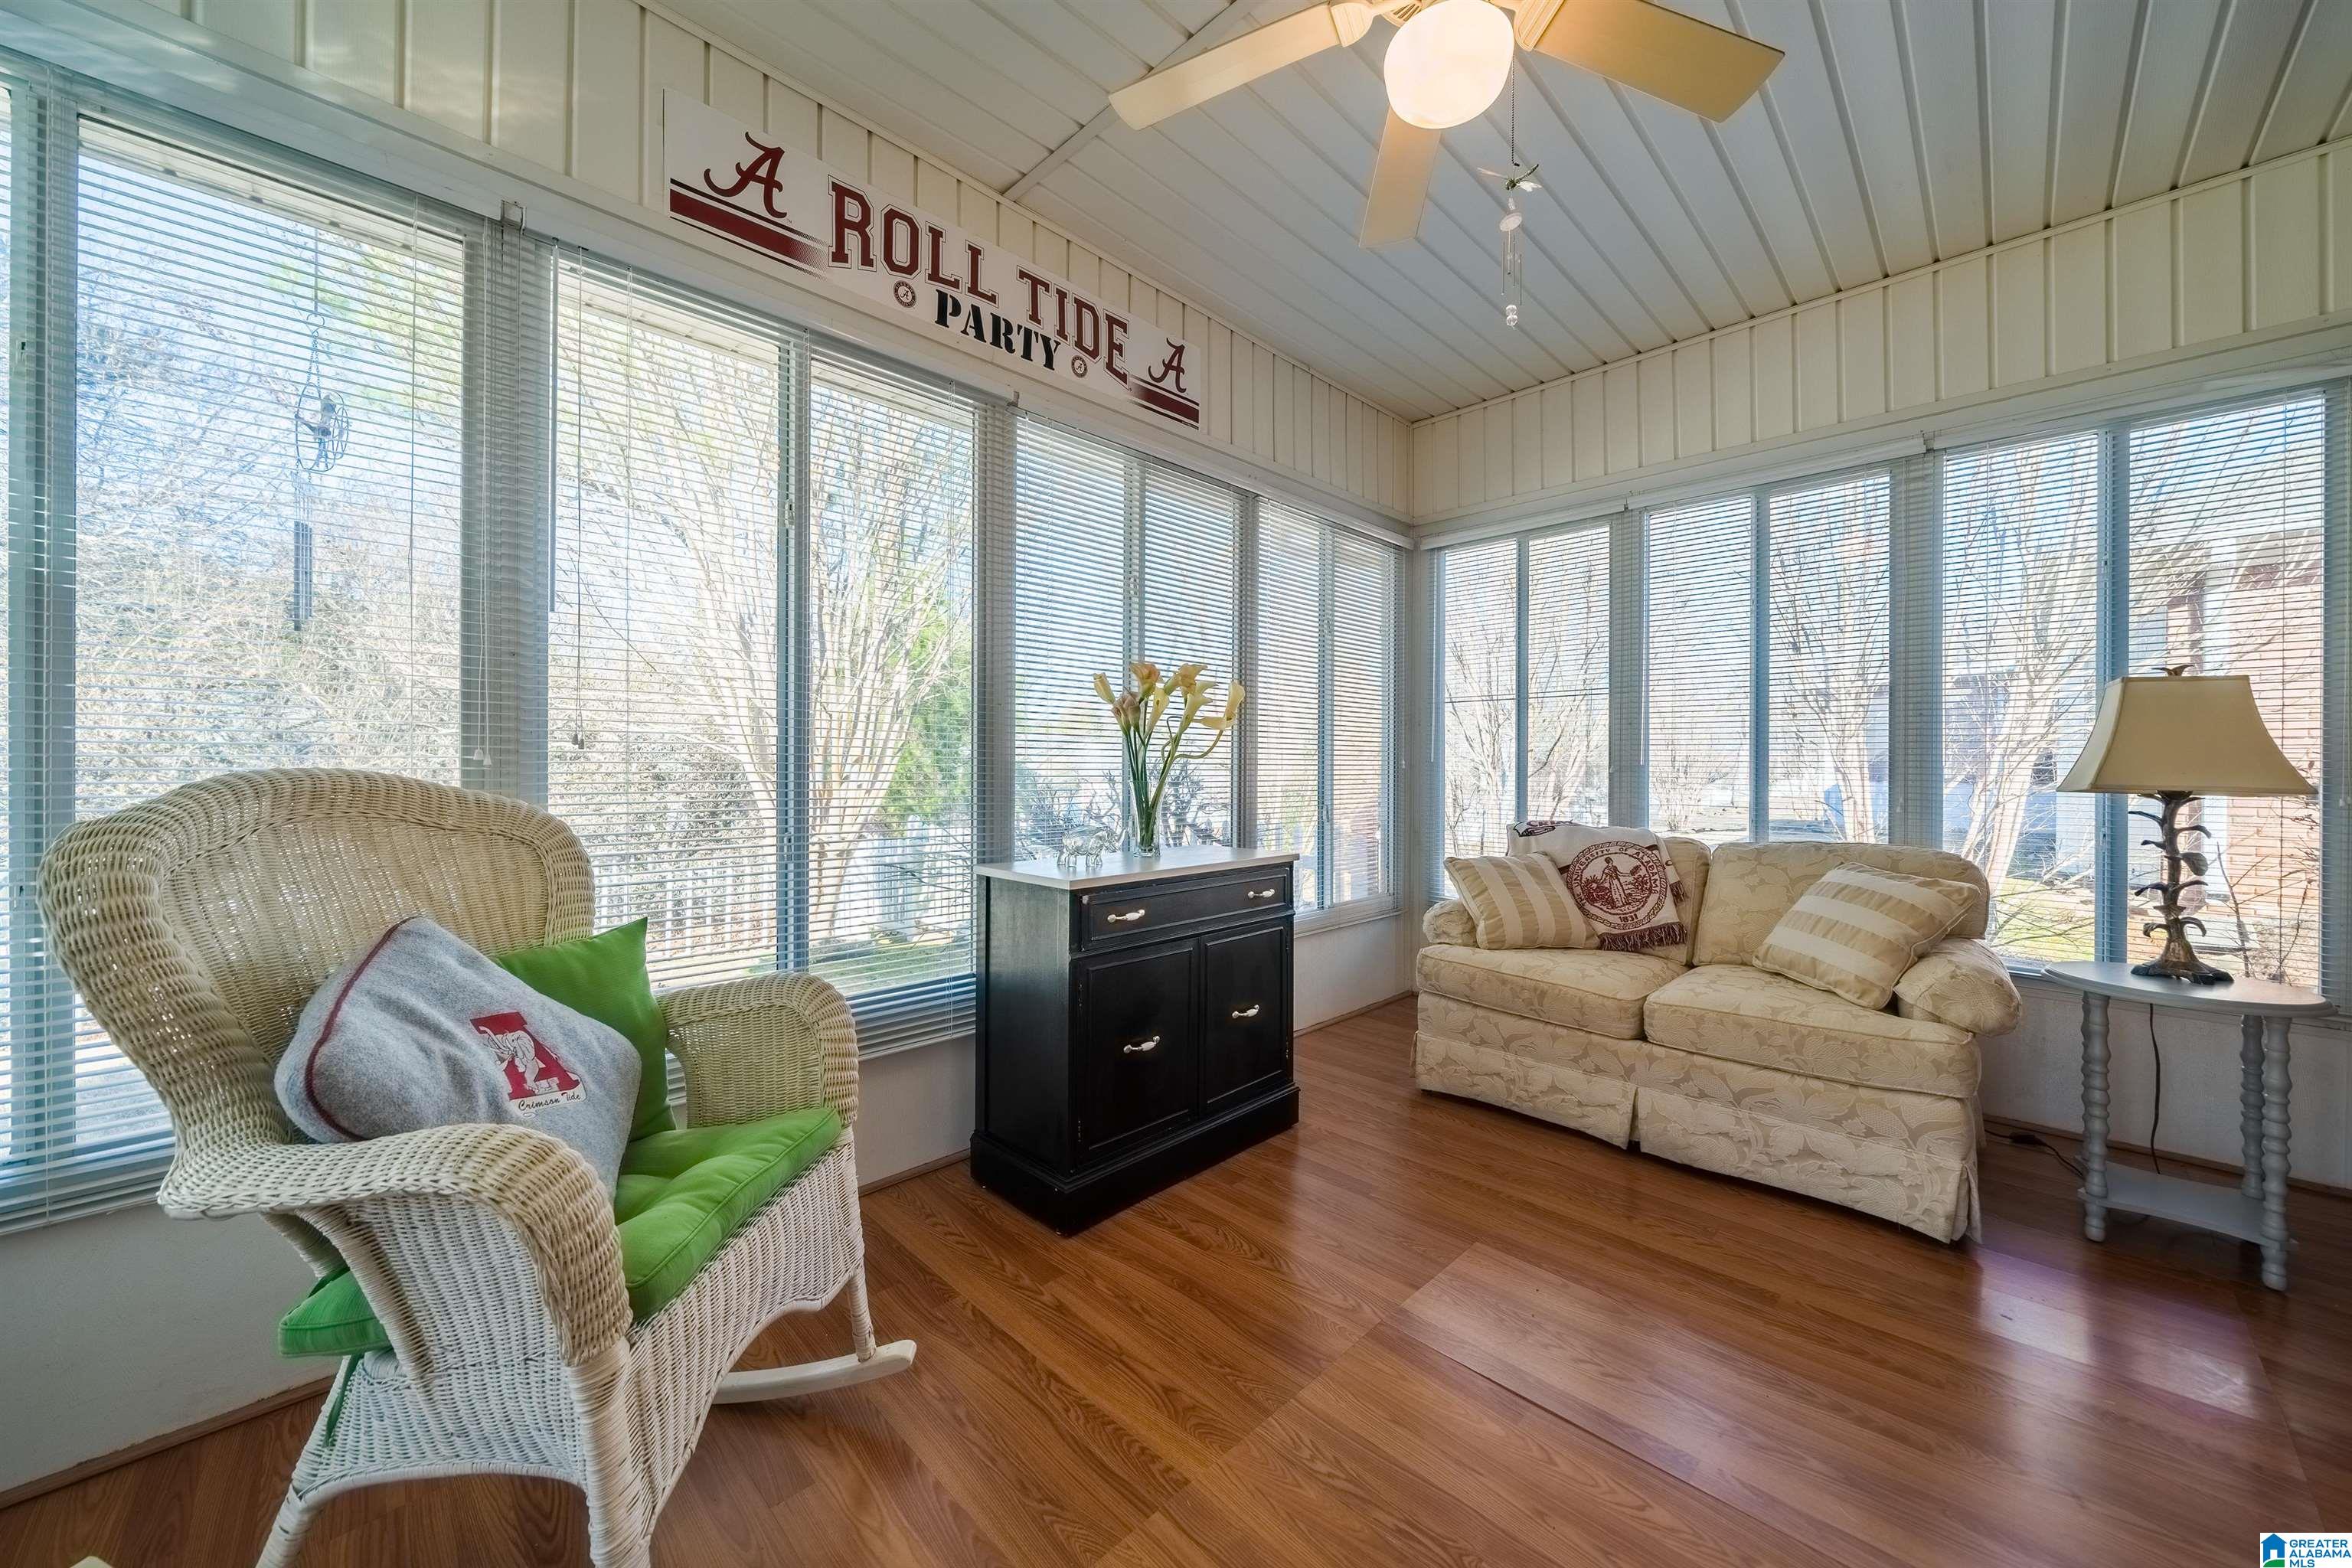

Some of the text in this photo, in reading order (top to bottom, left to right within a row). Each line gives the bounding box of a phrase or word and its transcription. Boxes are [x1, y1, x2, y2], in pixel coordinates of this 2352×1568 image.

[704, 131, 786, 219] A
[828, 174, 1129, 390] ROLL TIDE
[934, 289, 1061, 371] PARTY
[1148, 338, 1187, 393] A
[1573, 848, 1611, 889] UNIVERSITY
[1619, 913, 1639, 923] 1831
[518, 1091, 581, 1111] Crimson Tide
